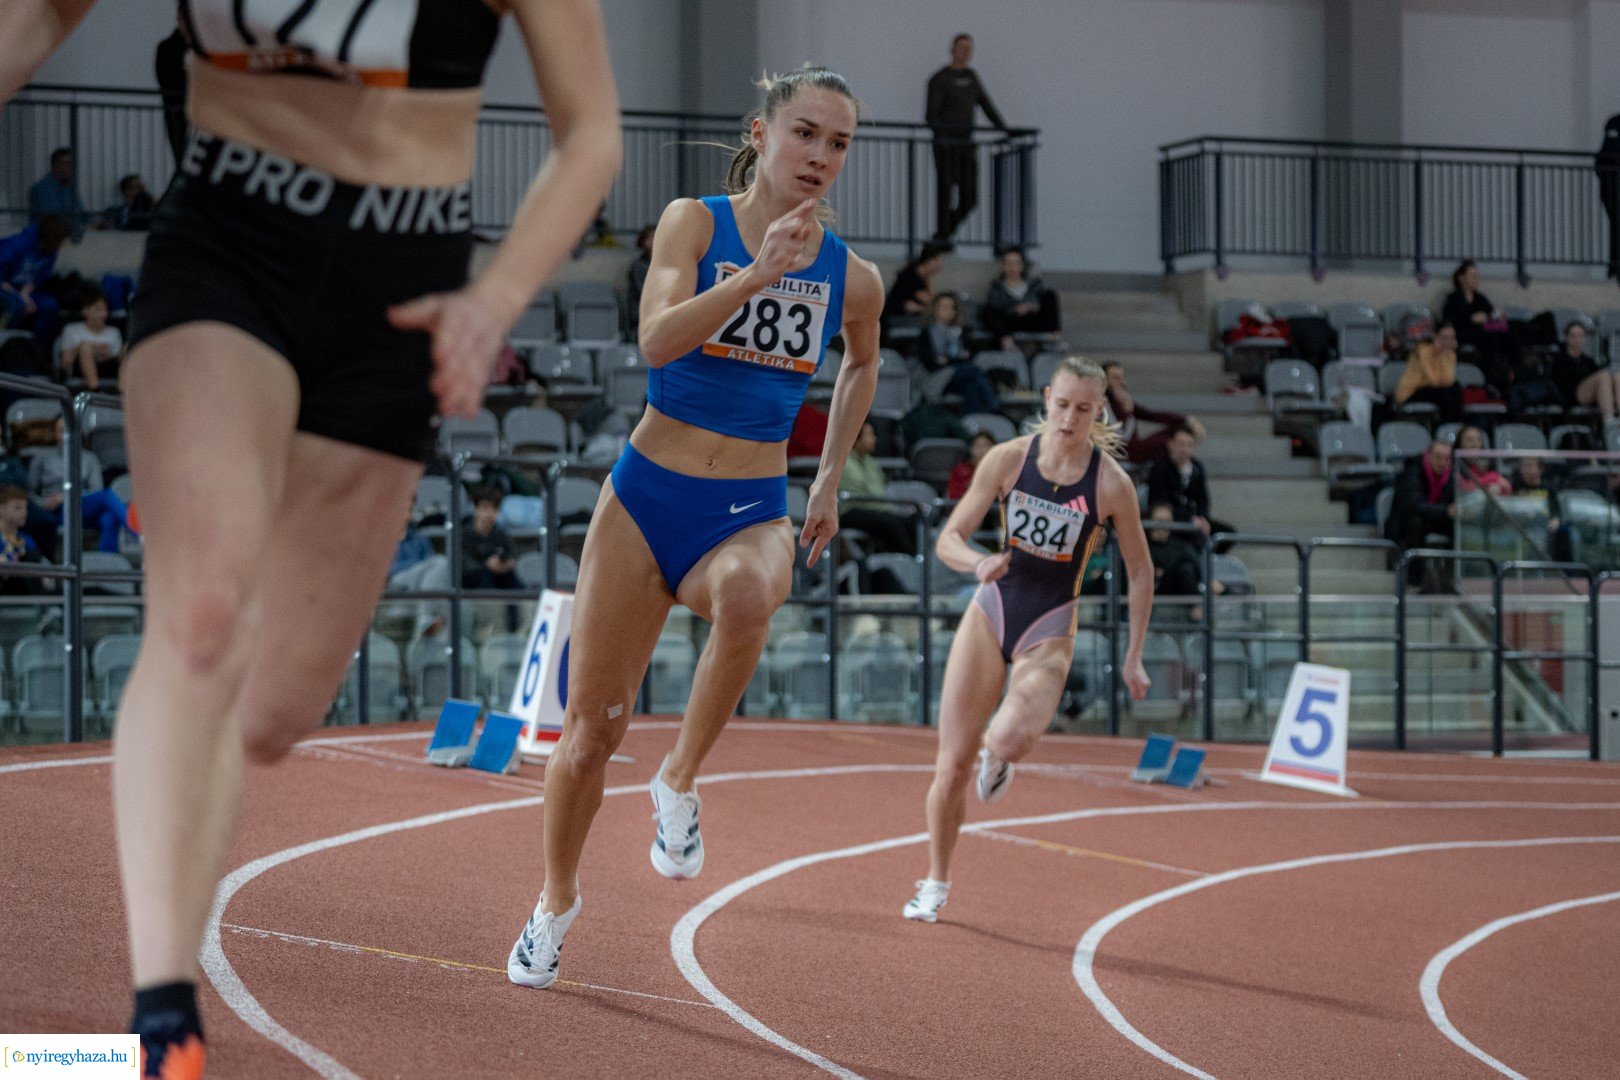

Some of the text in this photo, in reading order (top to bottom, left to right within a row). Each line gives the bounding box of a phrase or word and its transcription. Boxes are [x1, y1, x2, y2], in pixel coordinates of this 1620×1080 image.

[209, 140, 336, 216] PRO
[350, 184, 472, 234] NIKE
[719, 298, 812, 358] 283
[727, 348, 795, 370] ATLETIKA
[1012, 509, 1070, 552] 284
[1028, 496, 1079, 519] STABILITA
[521, 620, 549, 708] 6
[1289, 687, 1339, 759] 5
